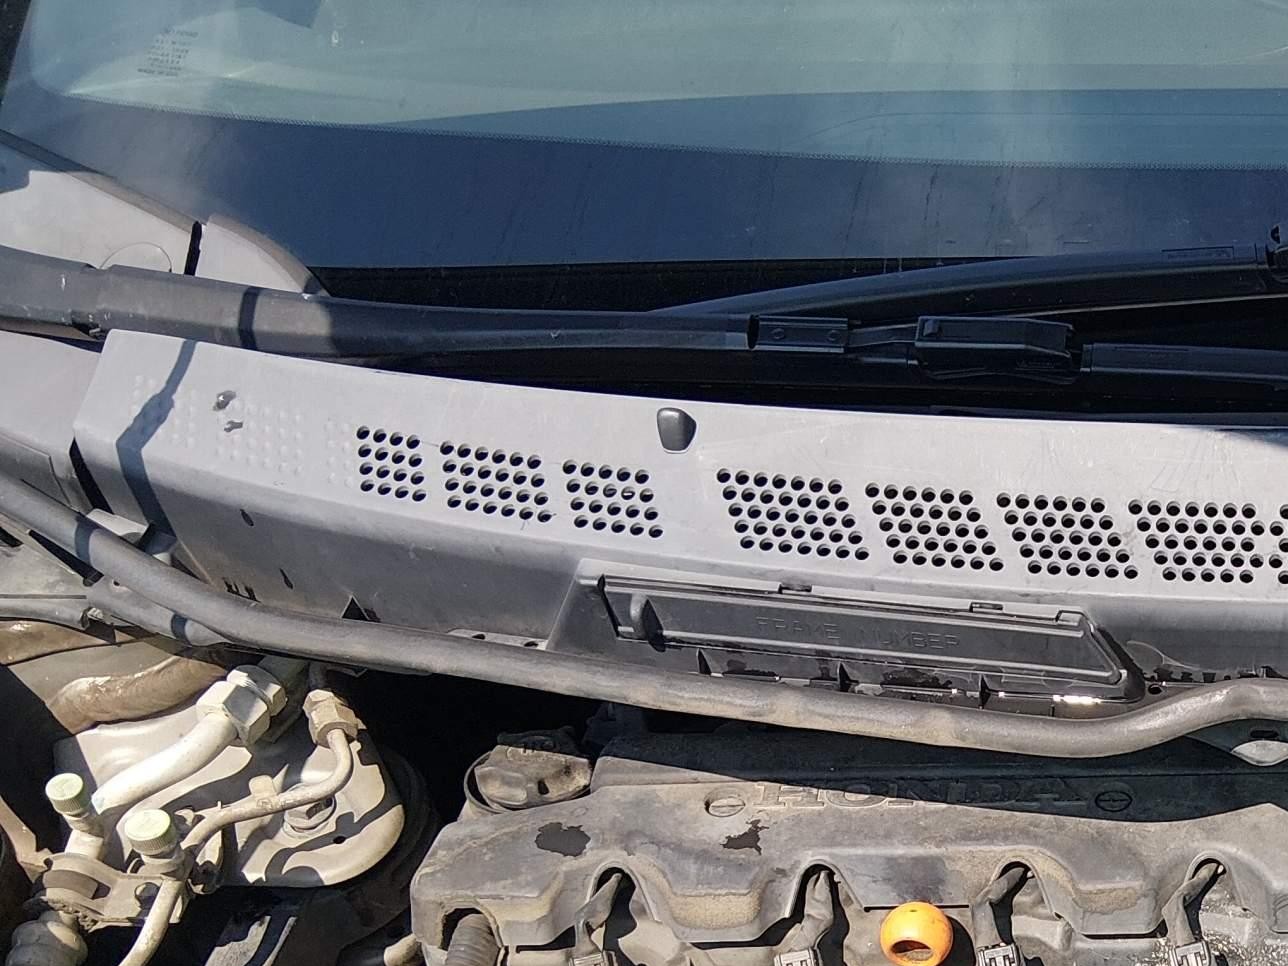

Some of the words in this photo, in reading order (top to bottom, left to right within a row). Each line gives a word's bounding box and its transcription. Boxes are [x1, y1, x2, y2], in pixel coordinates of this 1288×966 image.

[756, 615, 840, 640] FRAME
[858, 625, 961, 650] NUMBER
[753, 779, 1090, 809] HONDA
